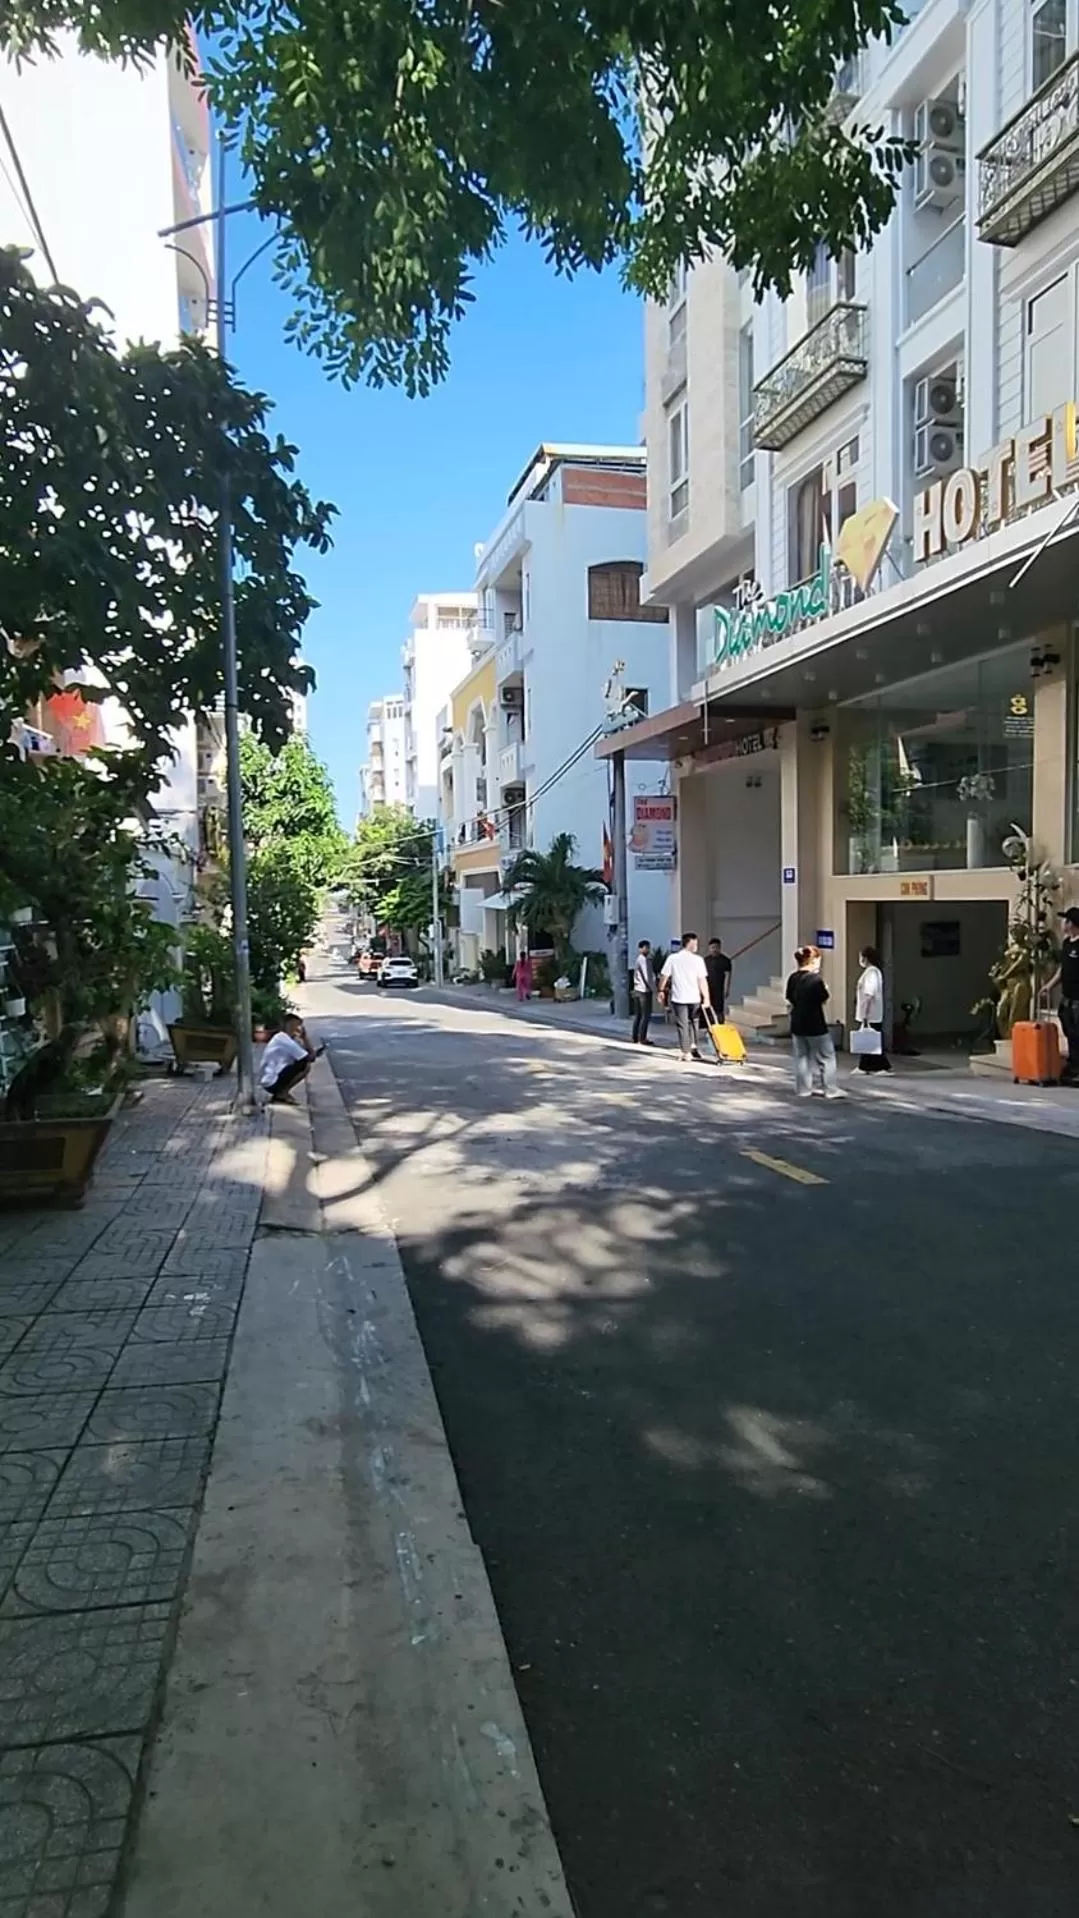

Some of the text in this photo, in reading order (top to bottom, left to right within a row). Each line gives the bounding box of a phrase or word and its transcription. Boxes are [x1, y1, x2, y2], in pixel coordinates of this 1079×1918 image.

[713, 400, 1079, 665] Diamond HOTEL
[732, 579, 764, 611] The
[636, 807, 672, 820] DIAMOND
